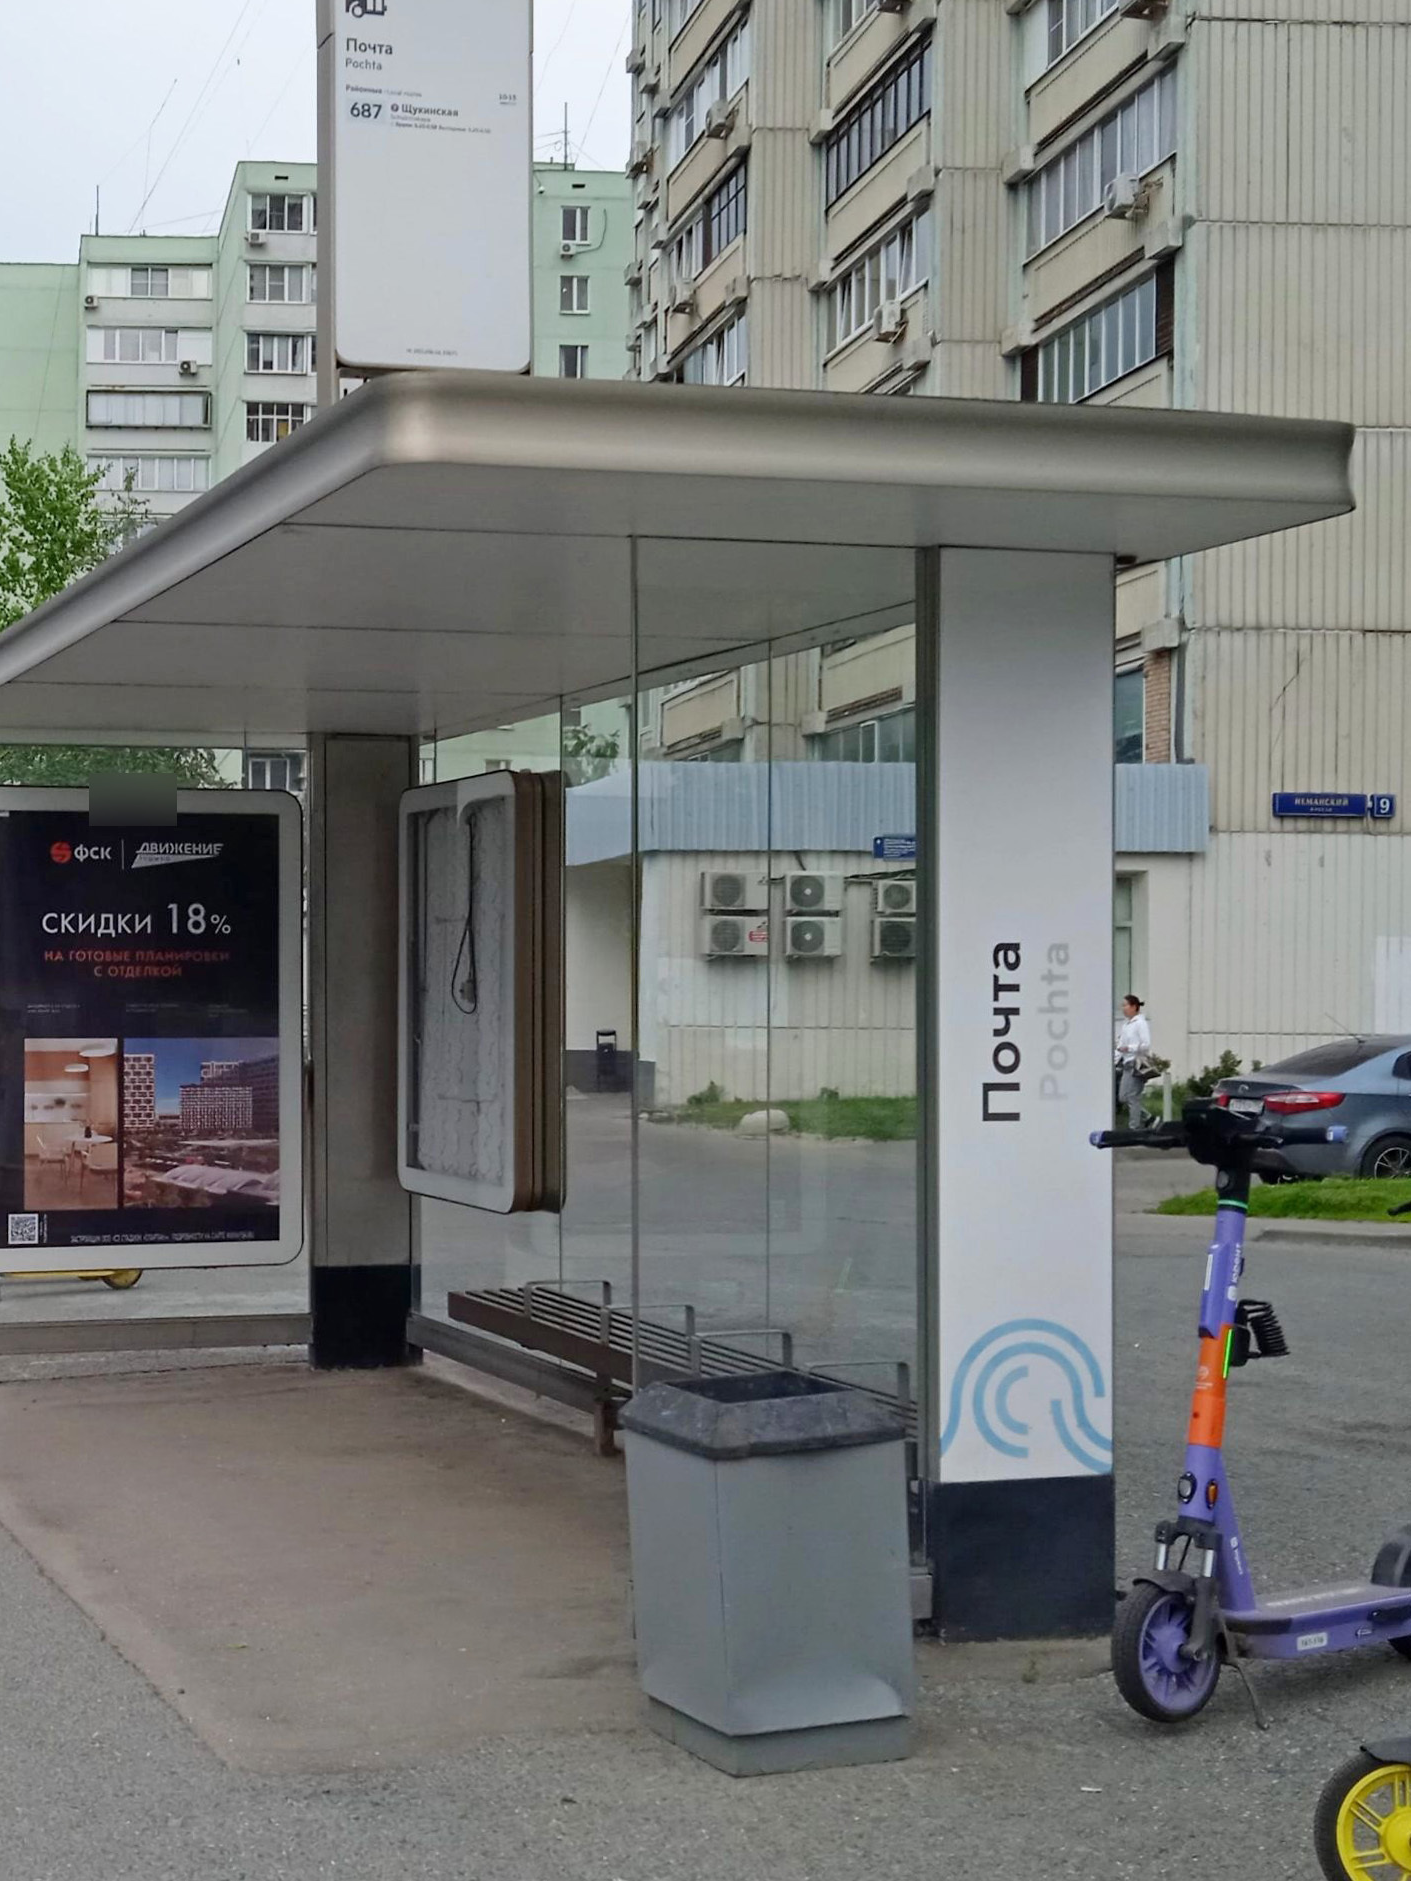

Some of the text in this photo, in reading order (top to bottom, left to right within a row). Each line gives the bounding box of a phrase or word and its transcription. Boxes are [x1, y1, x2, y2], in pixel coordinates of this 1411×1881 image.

[346, 37, 393, 56] Почта
[345, 57, 383, 72] Pochta
[350, 102, 382, 120] 687
[401, 103, 459, 118] Щукинская
[1379, 797, 1391, 814] 9
[135, 841, 225, 856] ДВИЖЕНИЕ
[41, 902, 232, 938] СКИДКИ 18%
[44, 950, 230, 963] НА ГОТОВЫЕ ПЛАНИРОВКИ
[93, 963, 182, 979] С ОТДЕЛКОЙ
[1038, 942, 1070, 1099] Pochta
[982, 942, 1021, 1122] Почта
